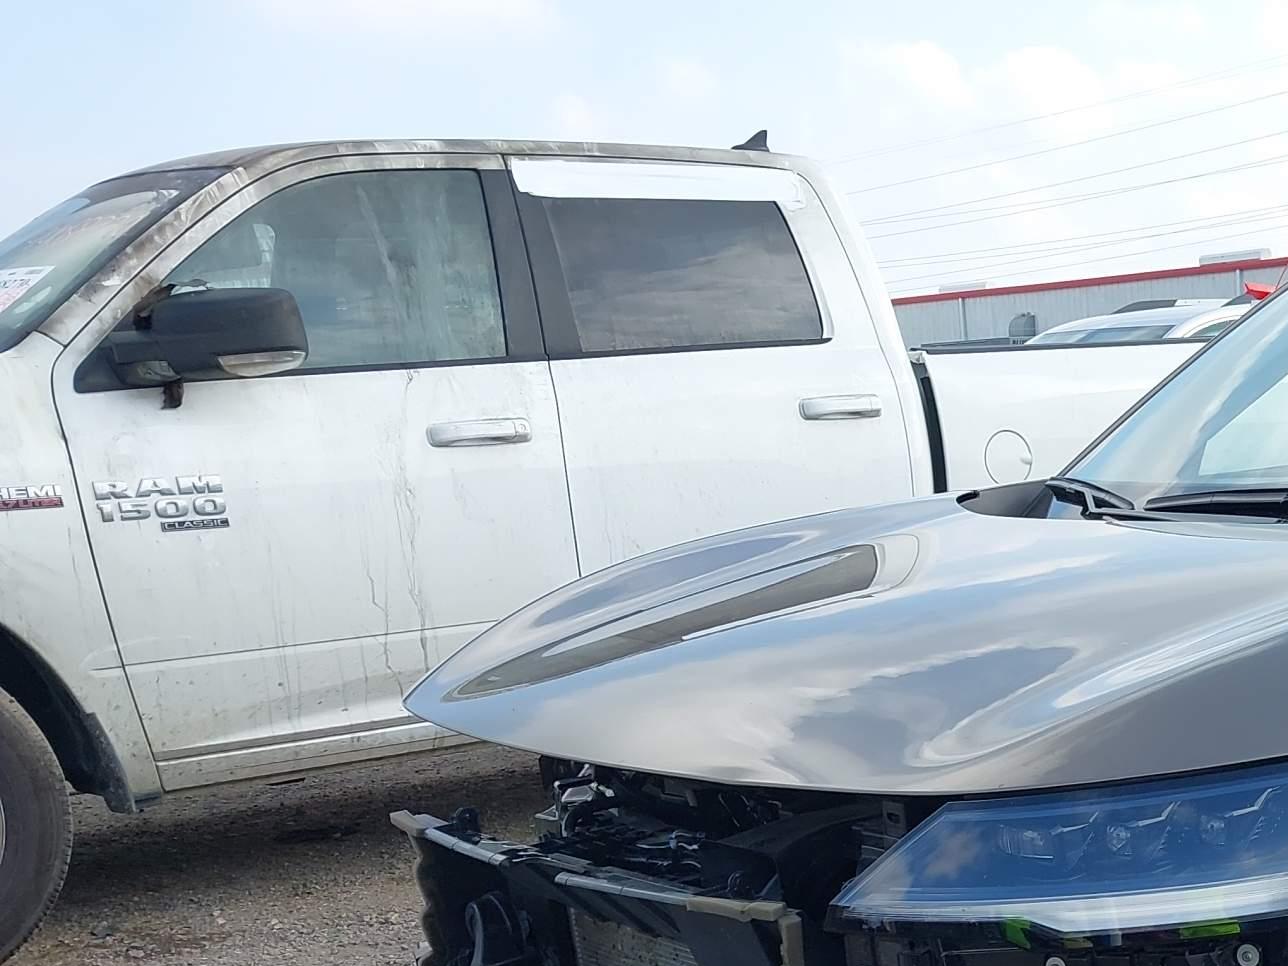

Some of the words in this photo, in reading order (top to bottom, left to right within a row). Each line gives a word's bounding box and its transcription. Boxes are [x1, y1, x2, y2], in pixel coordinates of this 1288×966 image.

[92, 474, 224, 500] RAM
[97, 497, 227, 523] 1500
[164, 518, 229, 531] CLASSIC
